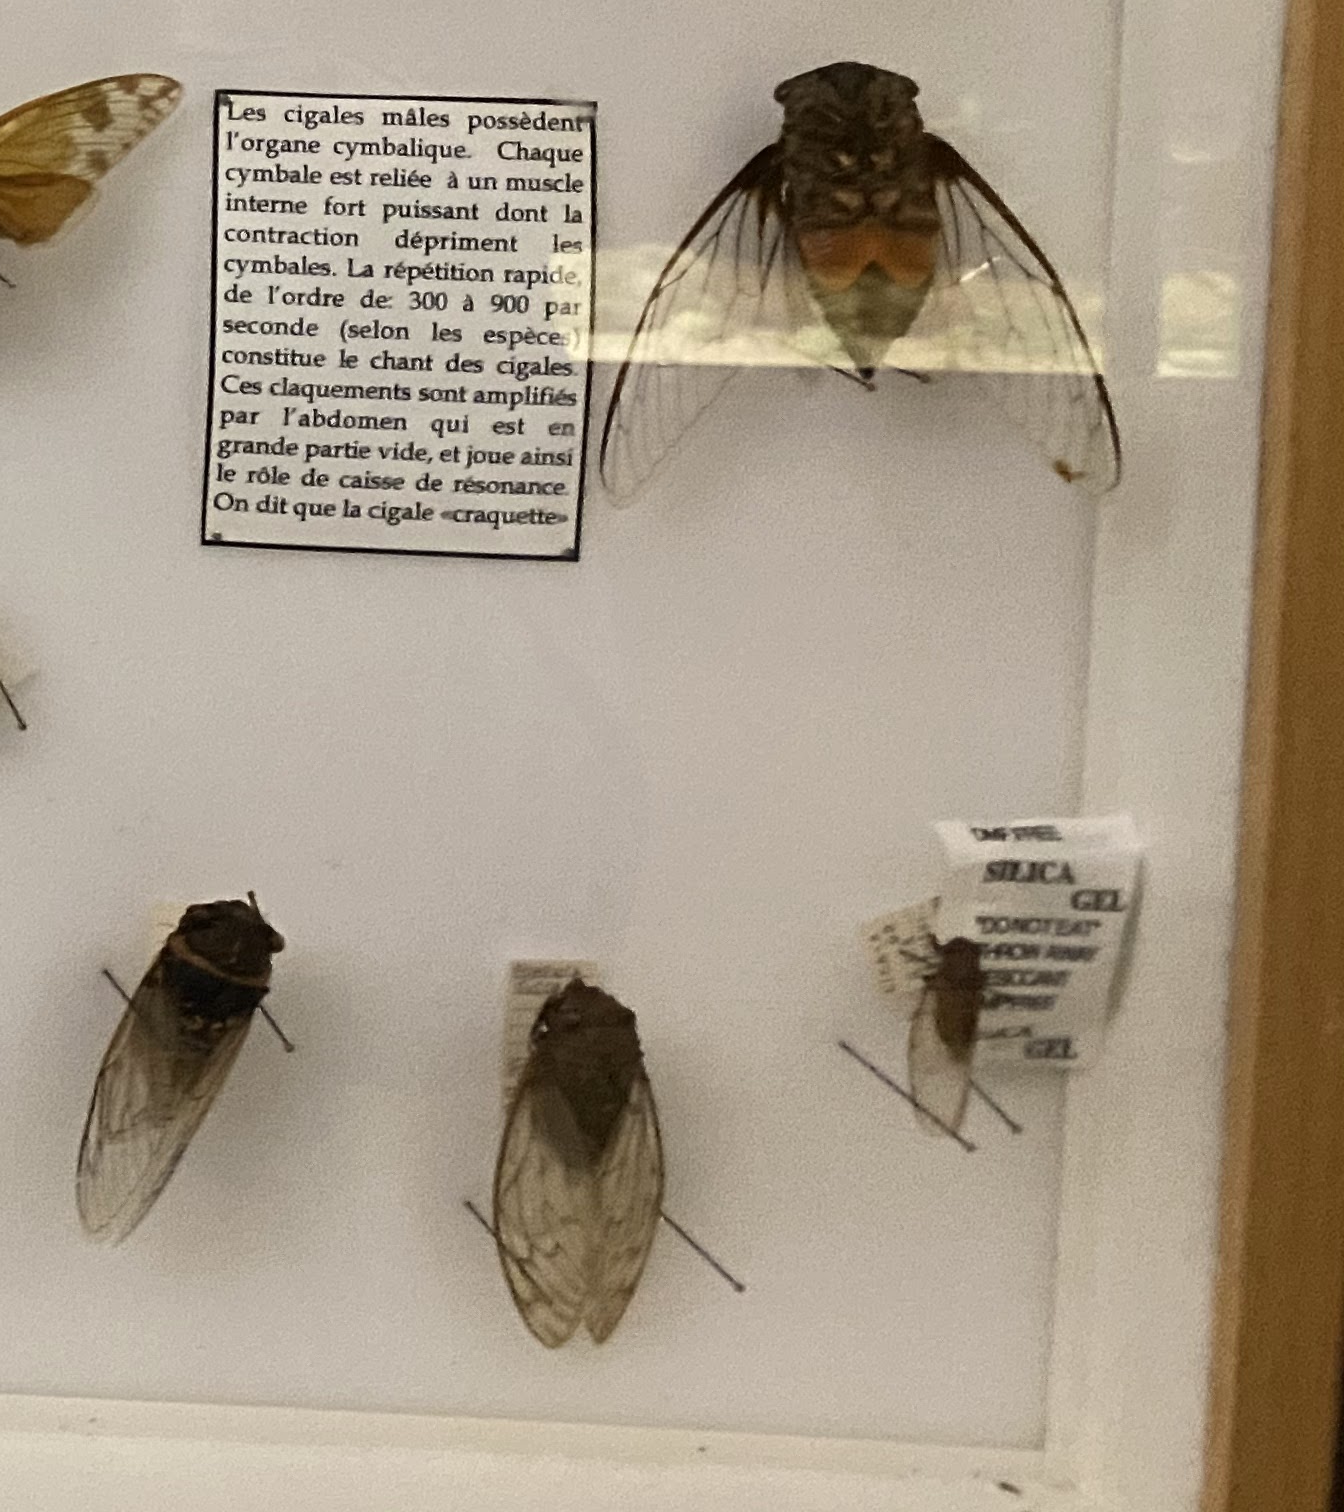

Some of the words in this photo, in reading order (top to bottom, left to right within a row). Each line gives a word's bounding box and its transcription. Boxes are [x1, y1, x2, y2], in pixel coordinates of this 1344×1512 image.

[226, 102, 267, 124] Les
[283, 104, 365, 131] cigales
[382, 107, 451, 129] mâles
[467, 110, 585, 135] possèdent
[332, 137, 472, 165] cymbalique.
[496, 140, 584, 169] Chaque
[224, 165, 323, 192] cymbale
[329, 171, 363, 188] est
[369, 168, 432, 190] reliée
[446, 169, 459, 190] à
[468, 177, 498, 191] un
[506, 172, 585, 193] muscle
[224, 194, 308, 217] interne
[323, 197, 366, 219] fort
[382, 199, 480, 225] puissant
[495, 201, 549, 224] dont
[563, 203, 583, 224] la
[224, 226, 359, 248] contraction
[394, 228, 519, 256] dépriment
[553, 232, 583, 254] les
[223, 255, 338, 281] cymbales.
[347, 258, 375, 279] La
[383, 259, 494, 286] répétition
[223, 284, 253, 306] de
[409, 291, 449, 312] 300
[462, 292, 475, 313] à
[490, 293, 530, 315] 900
[543, 302, 580, 322] par
[222, 317, 319, 339] seconde
[339, 319, 411, 346] (selon
[431, 321, 463, 343] les
[221, 347, 327, 369] constitue
[338, 349, 360, 370] le
[369, 350, 434, 373] chant
[445, 352, 485, 374] des
[220, 375, 263, 397] Ces
[268, 377, 412, 405] claquements
[418, 386, 467, 403] sont
[472, 384, 577, 411] amplifiés
[218, 411, 260, 432] par
[430, 412, 470, 439] qui
[491, 417, 525, 435] est
[548, 422, 575, 436] en
[216, 437, 300, 463] grande
[304, 440, 372, 465] partie
[377, 441, 433, 469] vide,
[438, 446, 462, 463] et
[466, 443, 516, 470] joue
[520, 445, 574, 467] ainsi
[215, 463, 238, 484] le
[245, 464, 291, 486] rôle
[300, 466, 330, 487] de
[338, 468, 406, 490] caisse
[414, 470, 443, 491] de
[213, 491, 250, 513] On
[255, 492, 289, 514] dit
[292, 501, 337, 521] que
[342, 496, 362, 517] la
[367, 497, 435, 525] cigale
